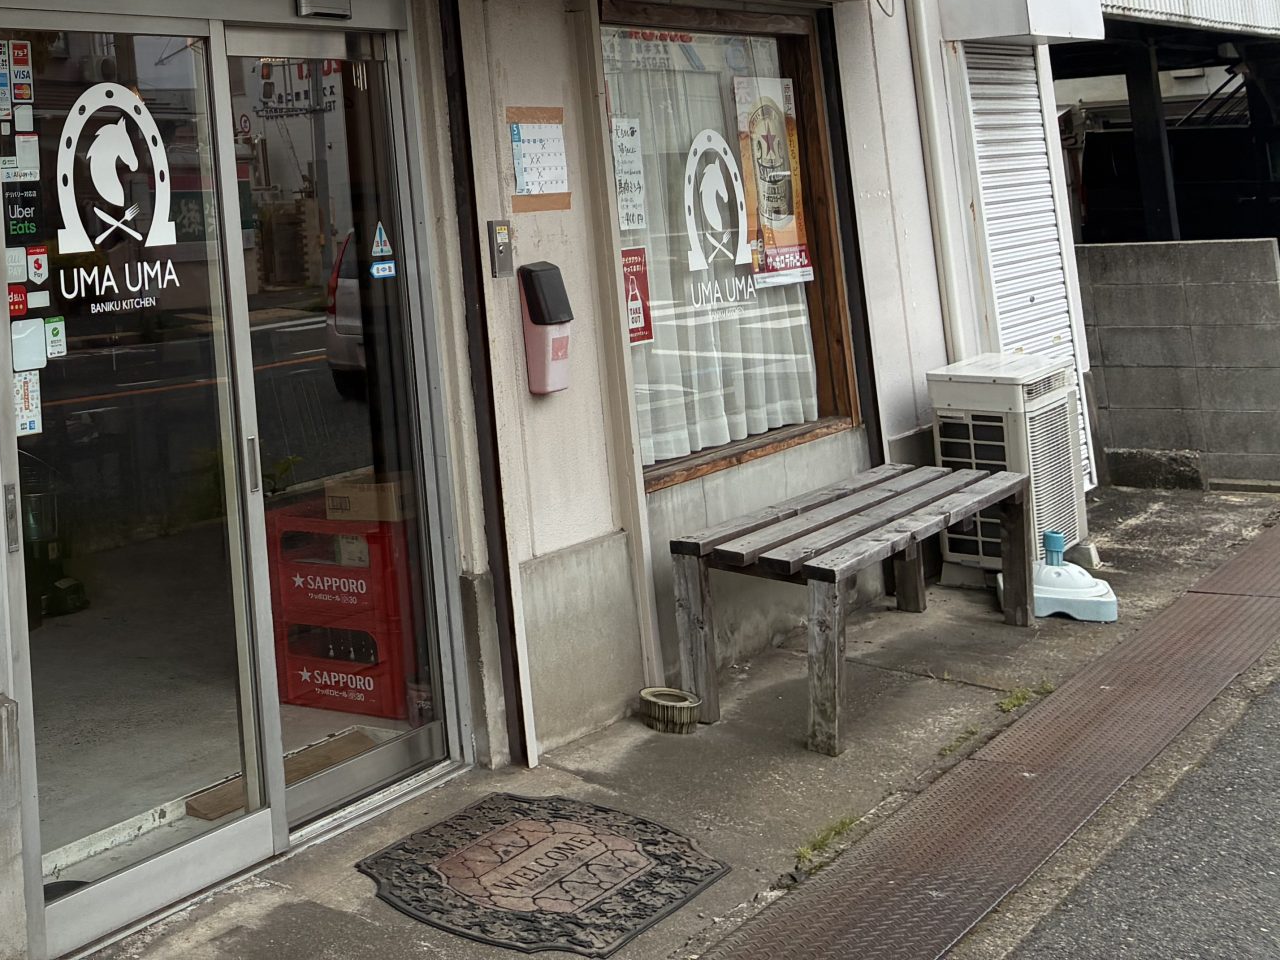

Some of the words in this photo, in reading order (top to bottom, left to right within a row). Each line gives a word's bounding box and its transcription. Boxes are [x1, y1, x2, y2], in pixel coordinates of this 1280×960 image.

[13, 69, 32, 80] VISA
[8, 205, 35, 218] Uber
[10, 221, 37, 235] Eats
[59, 264, 119, 299] UMA
[125, 259, 180, 292] UMA
[691, 280, 723, 308] UMA
[725, 274, 756, 302] UMA
[91, 300, 121, 314] BANIKU
[122, 296, 156, 310] KITCHEN
[629, 306, 642, 316] TAKE
[631, 315, 641, 325] OUT
[306, 575, 366, 594] SAPPORO
[314, 670, 374, 691] SAPPORO
[493, 836, 596, 891] WELCOME
